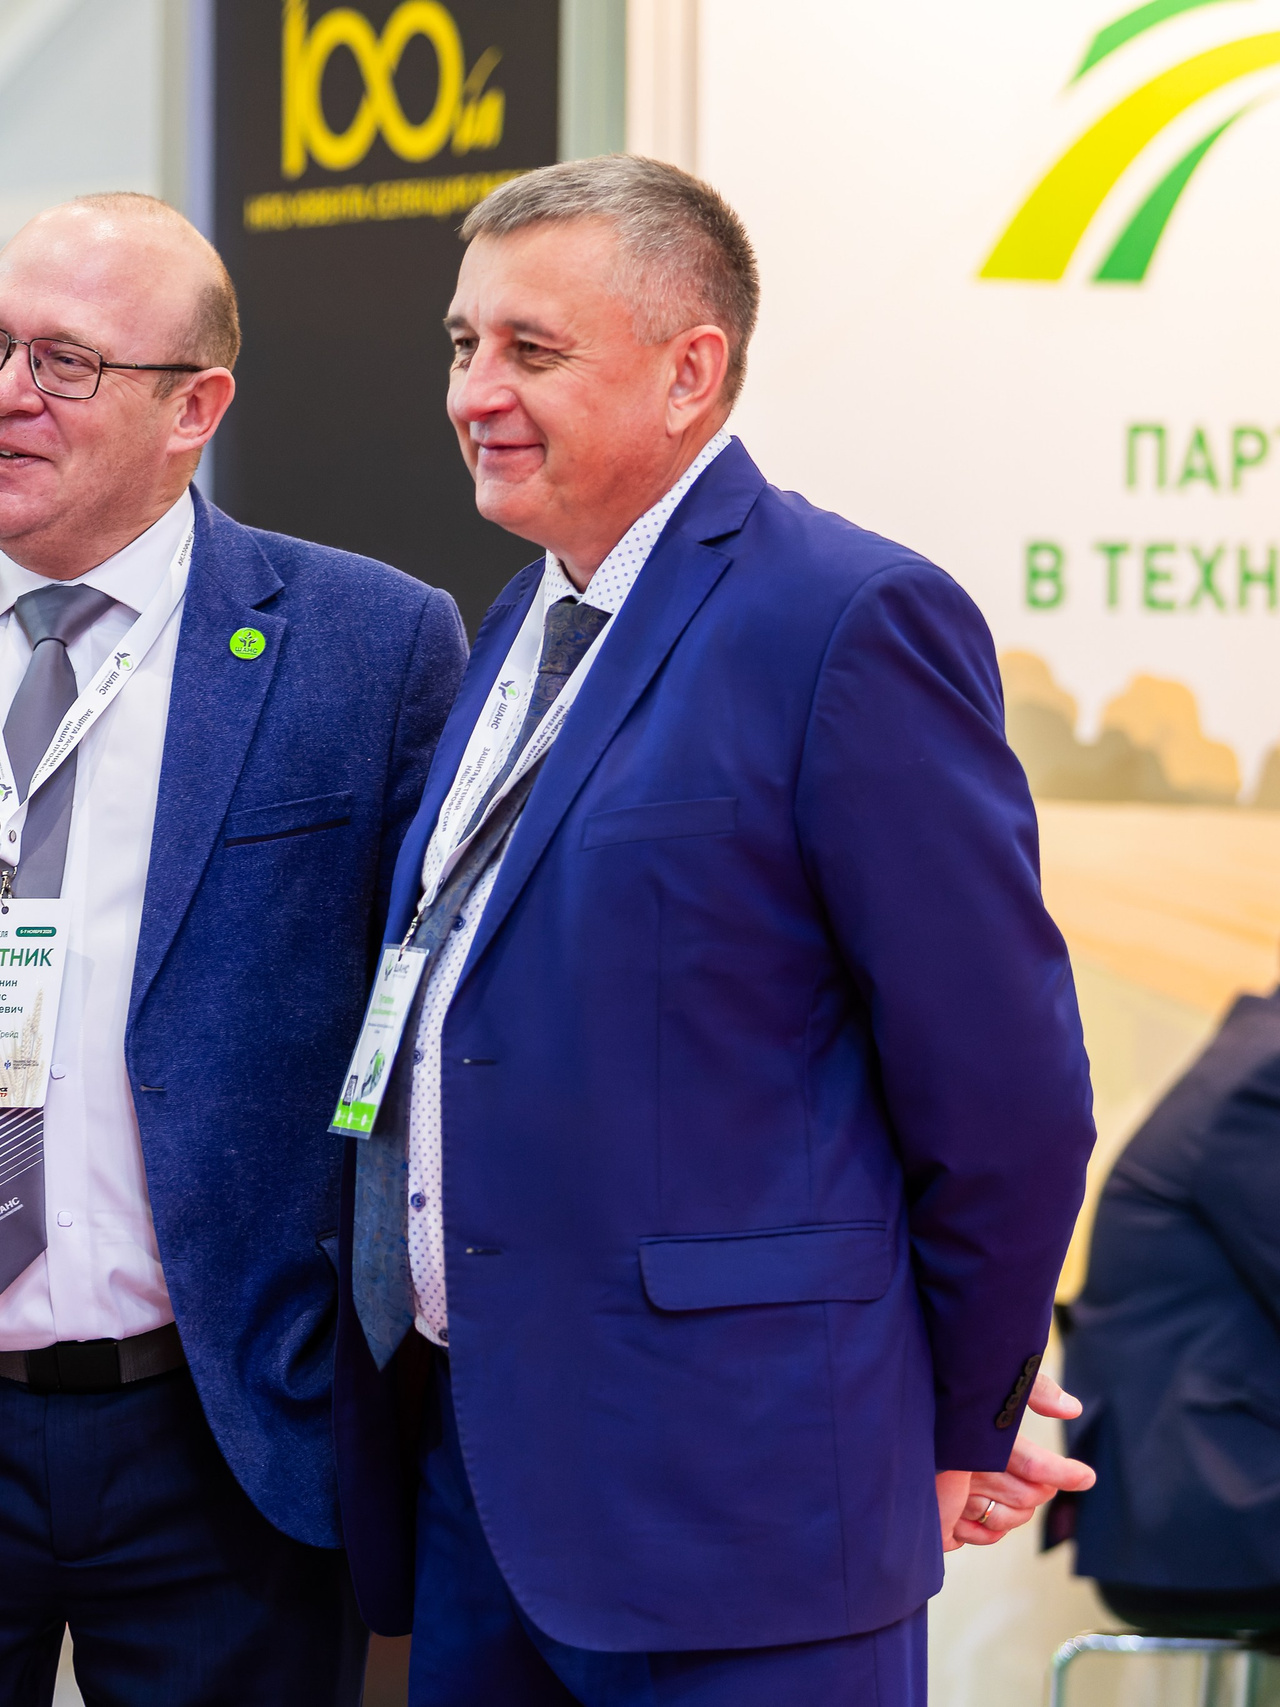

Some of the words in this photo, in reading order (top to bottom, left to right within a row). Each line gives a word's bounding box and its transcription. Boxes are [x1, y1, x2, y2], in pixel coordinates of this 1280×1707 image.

[1124, 420, 1280, 491] ПАР
[1024, 541, 1064, 611] В
[1092, 541, 1280, 612] ТЕХН
[235, 646, 258, 654] ШАНС
[99, 671, 120, 695] ШАНС
[71, 708, 94, 735] ЗАЩИТА
[490, 702, 508, 730] ШАНС
[536, 704, 565, 746] РАСТЕНИЙ
[57, 720, 74, 743] НАША
[48, 735, 75, 767] РАСТЕНИЙ
[533, 735, 552, 759] НАША
[457, 765, 472, 787] НАША
[471, 746, 491, 779] ЗАЩИТА
[453, 776, 477, 811] РАСТЕНИЙ
[441, 787, 462, 832] ПРОФЕССИЯ
